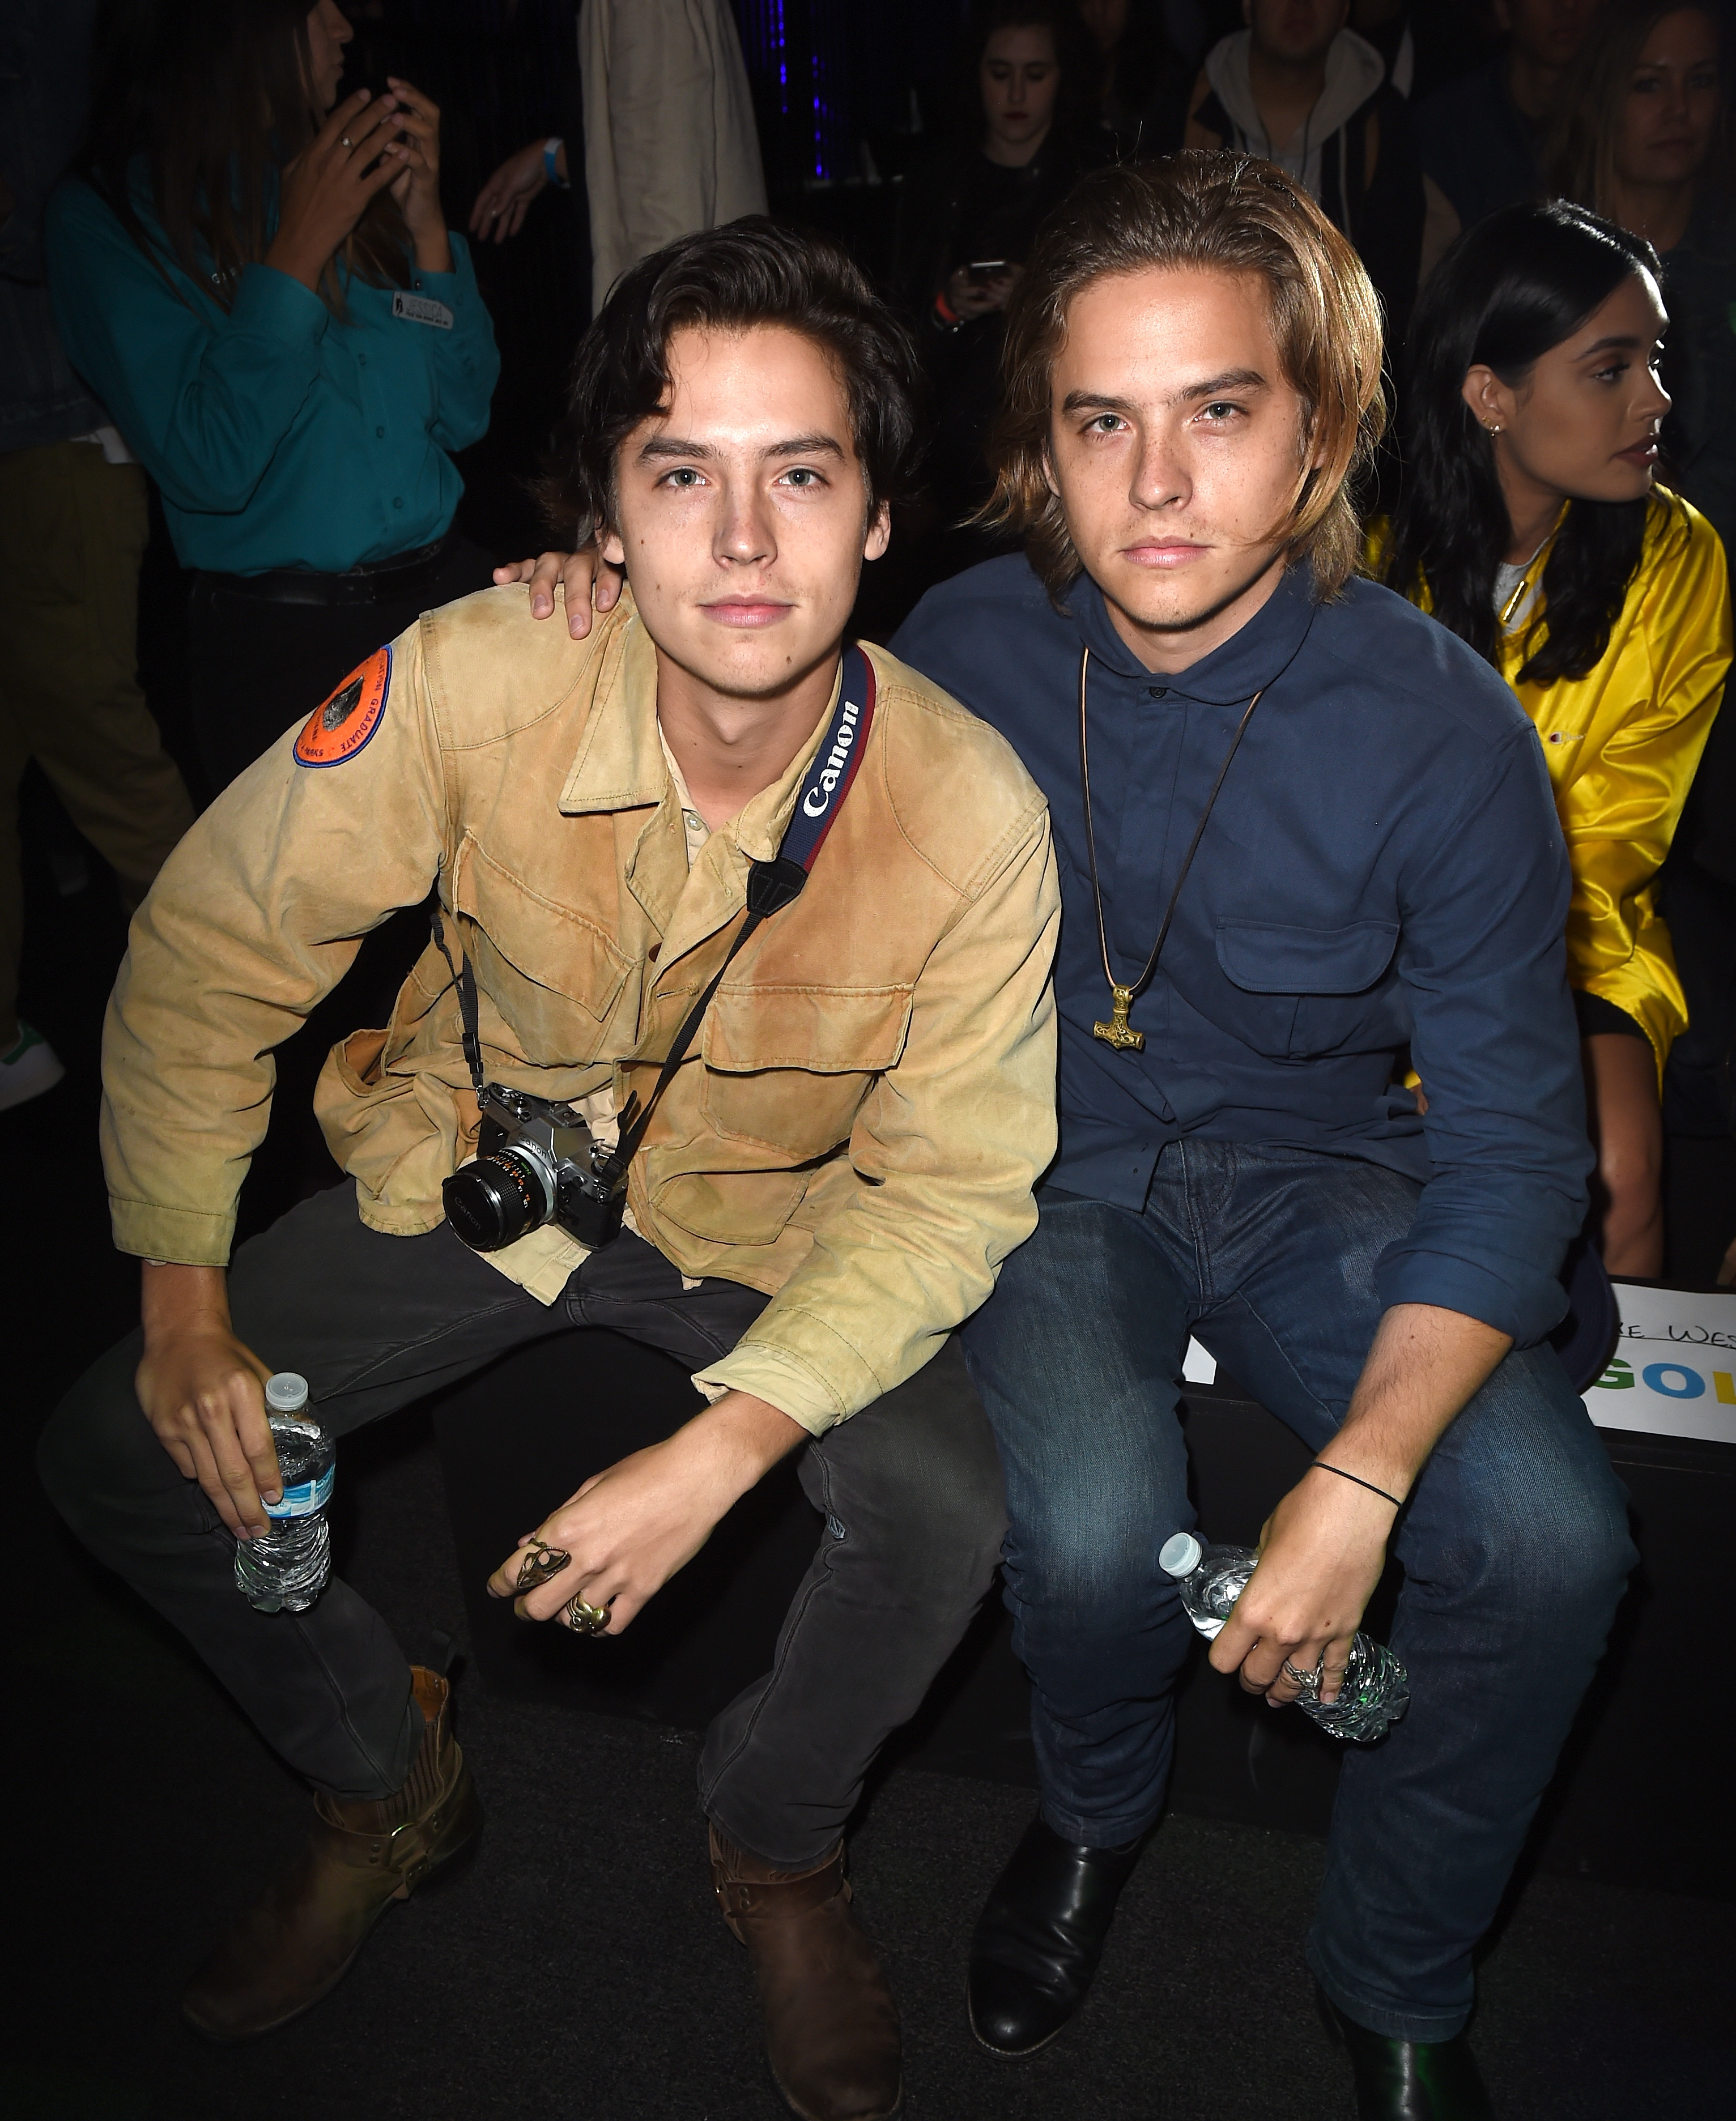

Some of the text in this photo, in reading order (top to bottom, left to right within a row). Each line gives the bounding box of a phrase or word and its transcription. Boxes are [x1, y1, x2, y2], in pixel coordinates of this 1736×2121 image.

[341, 698, 378, 752] GRADUATE
[803, 700, 859, 817] Canon
[519, 1132, 547, 1159] Canon
[454, 1196, 481, 1230] Canon
